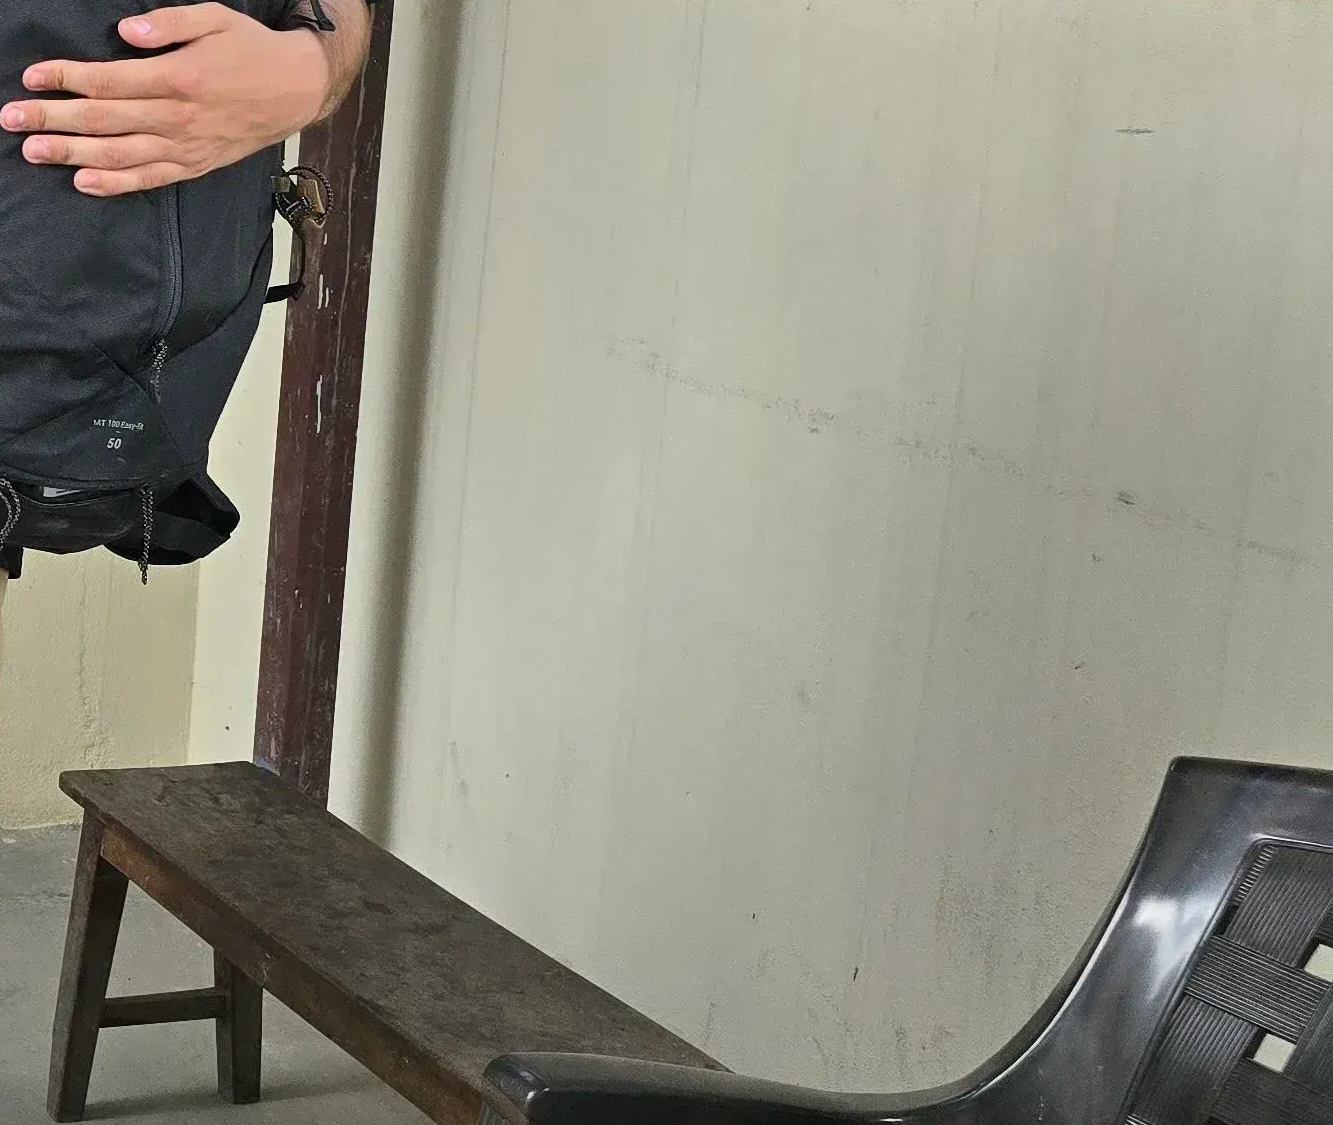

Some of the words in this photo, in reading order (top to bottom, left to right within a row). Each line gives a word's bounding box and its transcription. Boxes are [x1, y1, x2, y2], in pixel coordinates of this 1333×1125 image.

[93, 419, 107, 427] MT
[108, 419, 121, 427] 100
[106, 437, 122, 450] 50
